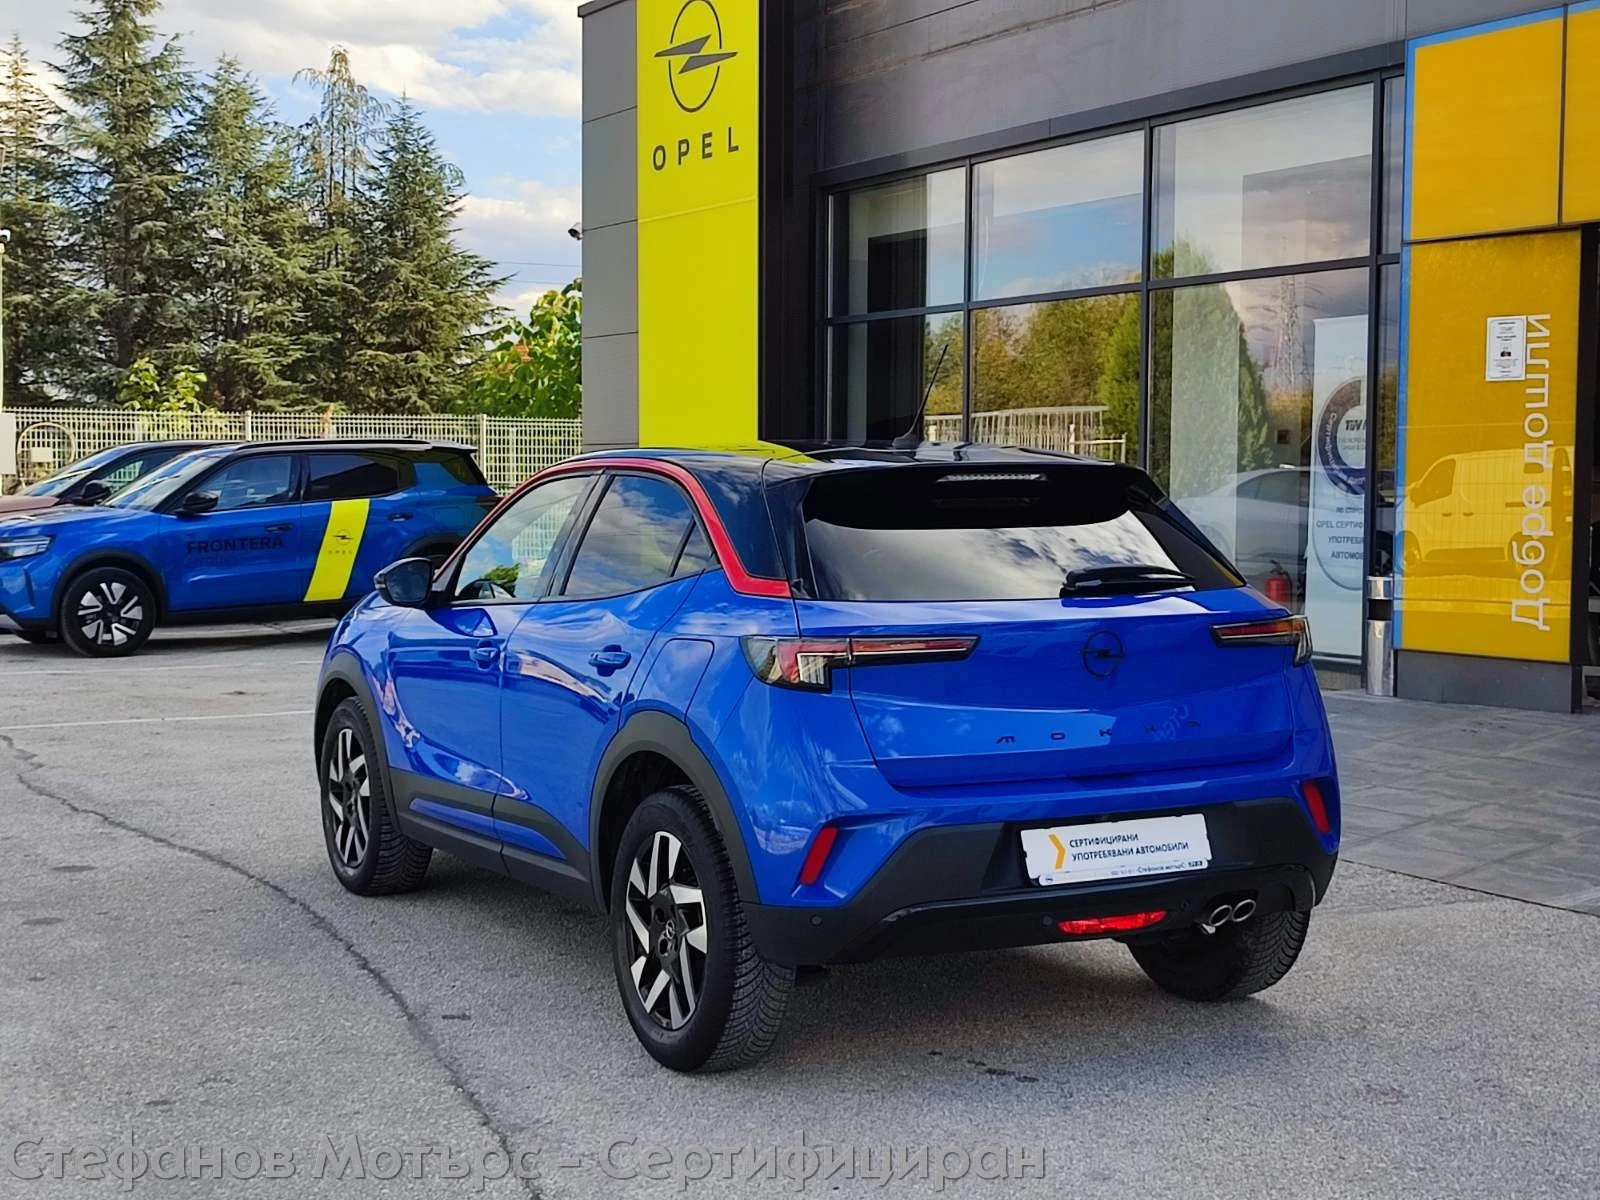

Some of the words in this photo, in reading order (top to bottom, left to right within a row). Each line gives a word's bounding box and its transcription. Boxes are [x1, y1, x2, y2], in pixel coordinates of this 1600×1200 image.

[653, 127, 739, 171] OPEL
[1522, 313, 1554, 468] дошли
[187, 536, 284, 554] FRONTERA
[1511, 485, 1553, 632] Добре
[1070, 834, 1139, 848] СЕРТИФИЦИРАНИ
[1072, 848, 1134, 861] УПОТРЕБЯВАНИ
[1136, 842, 1189, 855] АВТОМОБИЛИ
